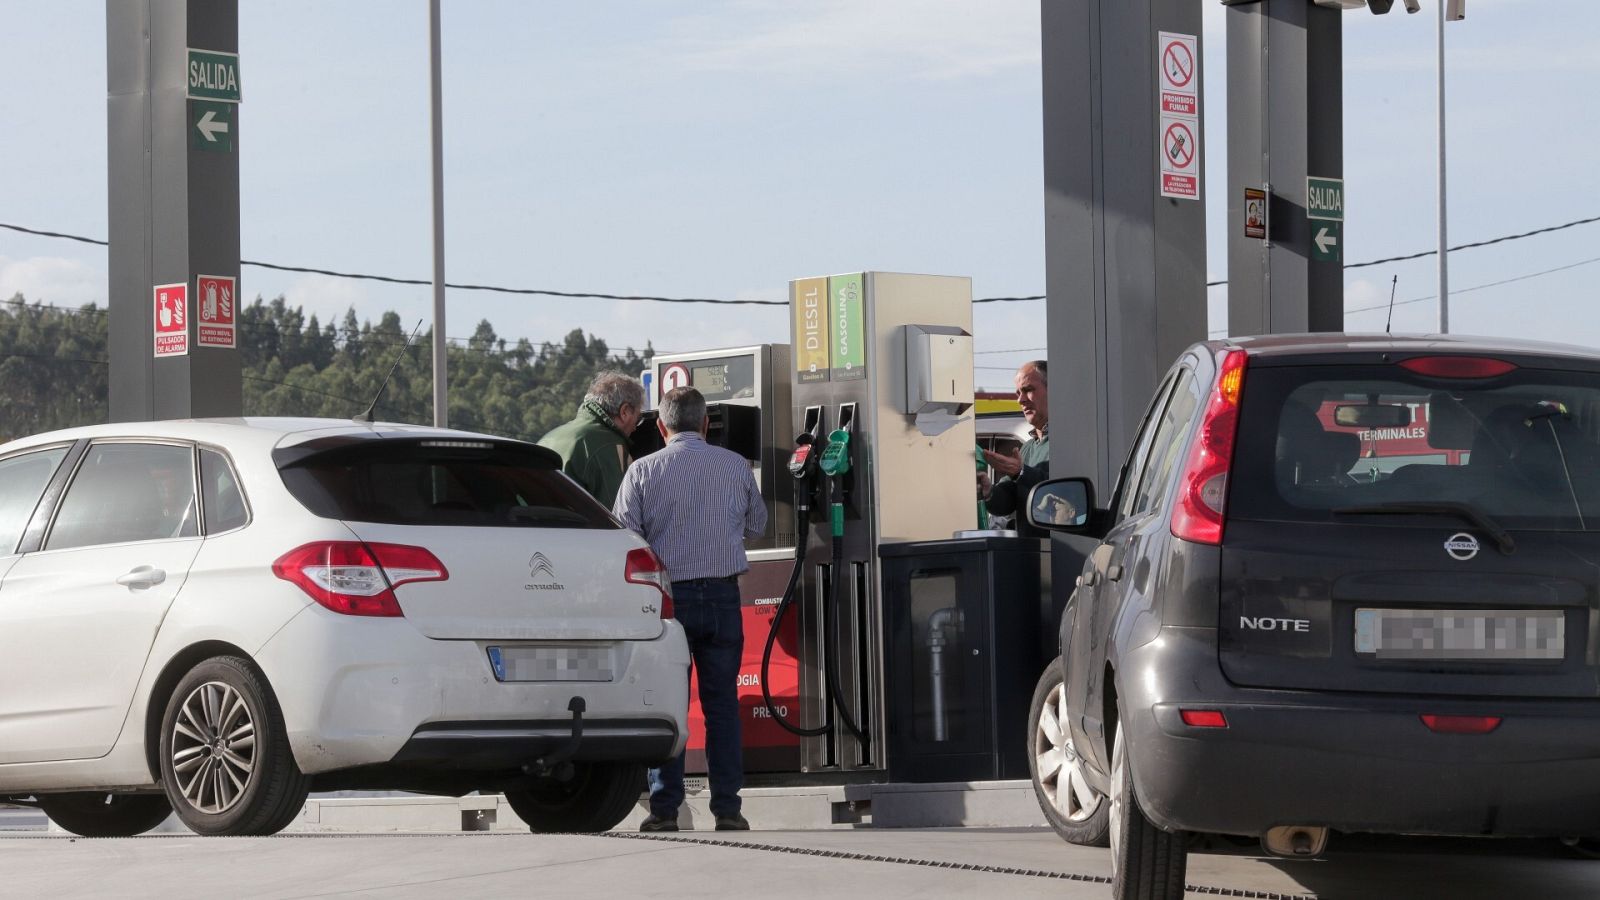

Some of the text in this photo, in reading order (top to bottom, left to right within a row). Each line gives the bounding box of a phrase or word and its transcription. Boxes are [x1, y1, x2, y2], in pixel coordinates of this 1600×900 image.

[190, 60, 238, 91] SALIDA
[1163, 94, 1195, 105] PROHIBIDO
[1169, 103, 1189, 112] FUMAR
[1309, 187, 1342, 211] SALIDA
[848, 281, 858, 300] 95
[805, 287, 818, 350] DIESEL
[839, 287, 847, 356] GASOLINA
[157, 335, 185, 345] PULSADOR
[165, 344, 185, 352] ALARMA
[670, 371, 678, 387] 1
[1357, 427, 1426, 441] TERMINALES
[754, 597, 783, 605] COMBUSTI
[641, 604, 657, 613] C4
[755, 606, 771, 615] LOW
[1240, 616, 1310, 632] NOTE
[753, 705, 788, 718] PREIO
